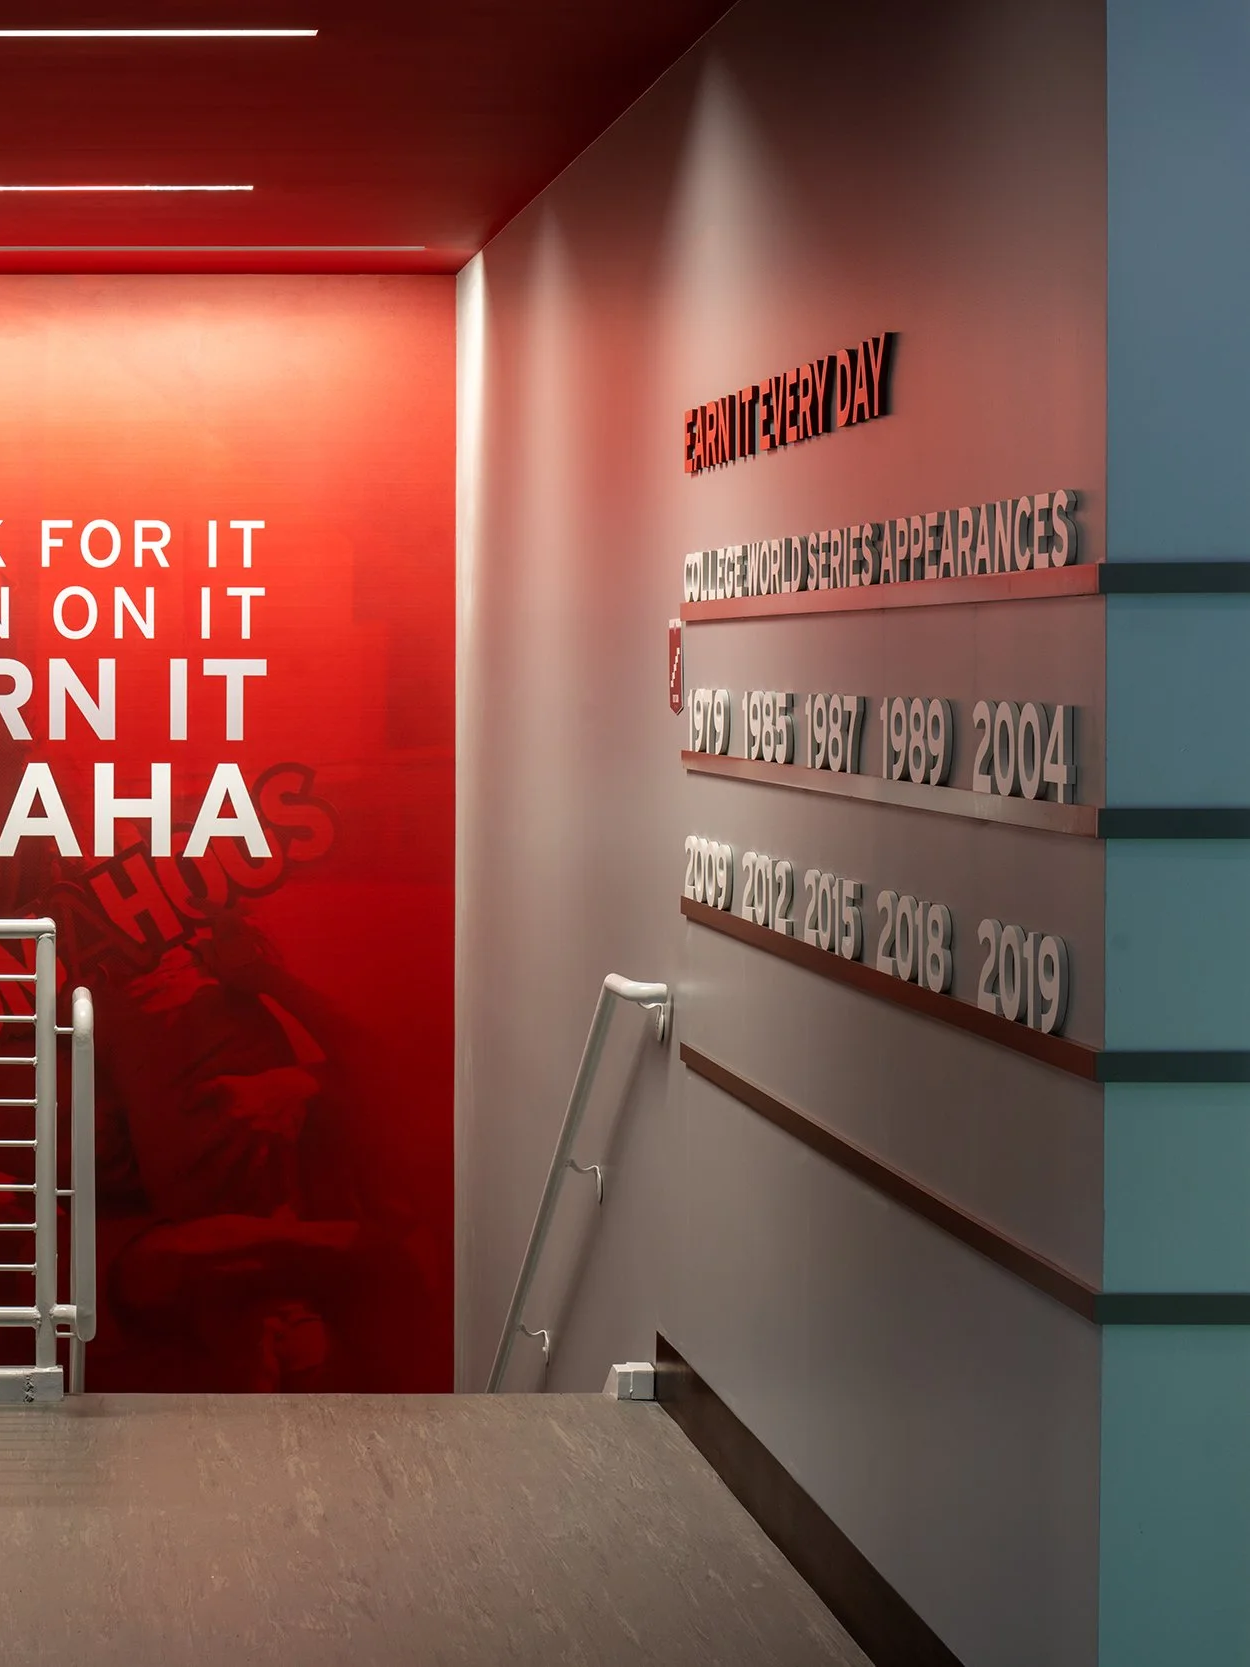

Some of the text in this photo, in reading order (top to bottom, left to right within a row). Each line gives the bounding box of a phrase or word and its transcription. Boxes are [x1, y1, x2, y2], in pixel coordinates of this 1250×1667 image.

[684, 332, 899, 474] EARN IT EVERY DAY
[41, 519, 171, 568] FOR
[208, 520, 265, 568] IT
[684, 489, 1077, 602] COLLEGE WORLD SERIES APPEARANCES
[53, 585, 155, 640] ON
[201, 586, 266, 640] IT
[169, 658, 267, 741] IT
[687, 688, 1077, 804] 1979 1985 1987 1989 2004
[684, 835, 1069, 1034] 2009 2012 2015 2018 2019
